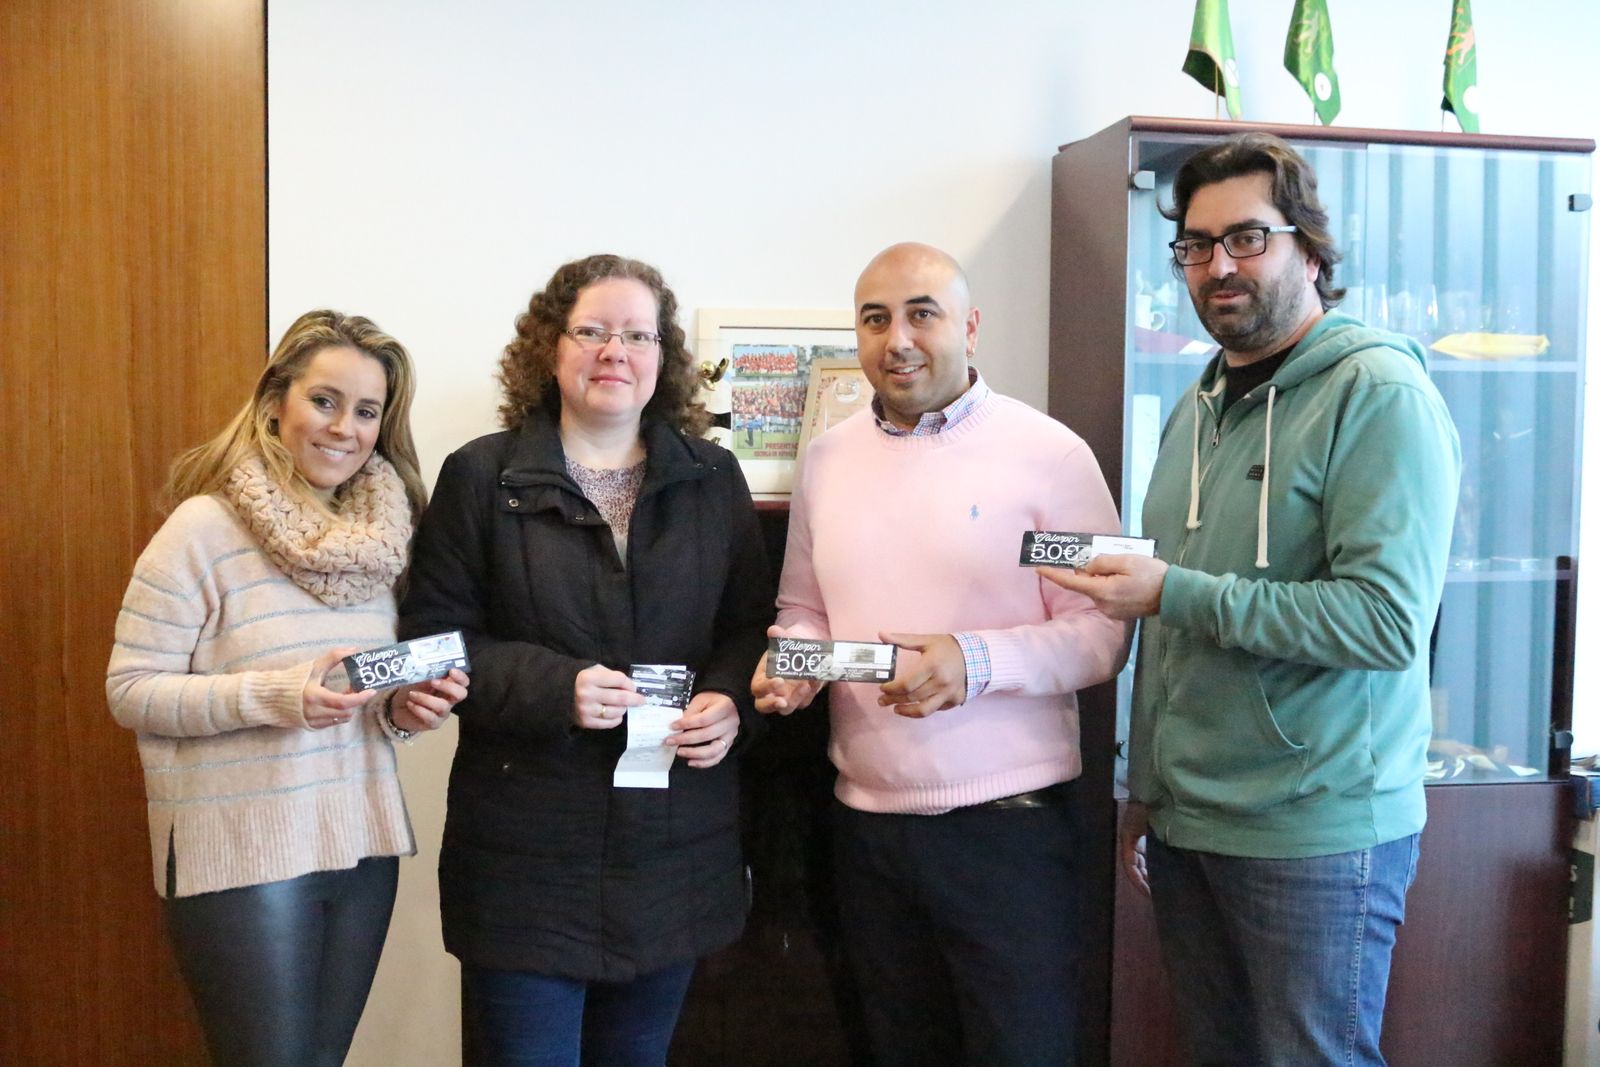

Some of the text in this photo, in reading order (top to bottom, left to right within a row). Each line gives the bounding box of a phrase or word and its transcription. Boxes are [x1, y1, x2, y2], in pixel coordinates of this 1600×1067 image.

[1034, 532, 1080, 545] Vale por
[1030, 543, 1079, 561] 50€
[779, 639, 821, 653] Vale por
[356, 649, 399, 668] Vale por
[775, 652, 821, 672] 50€
[359, 657, 406, 685] 50€
